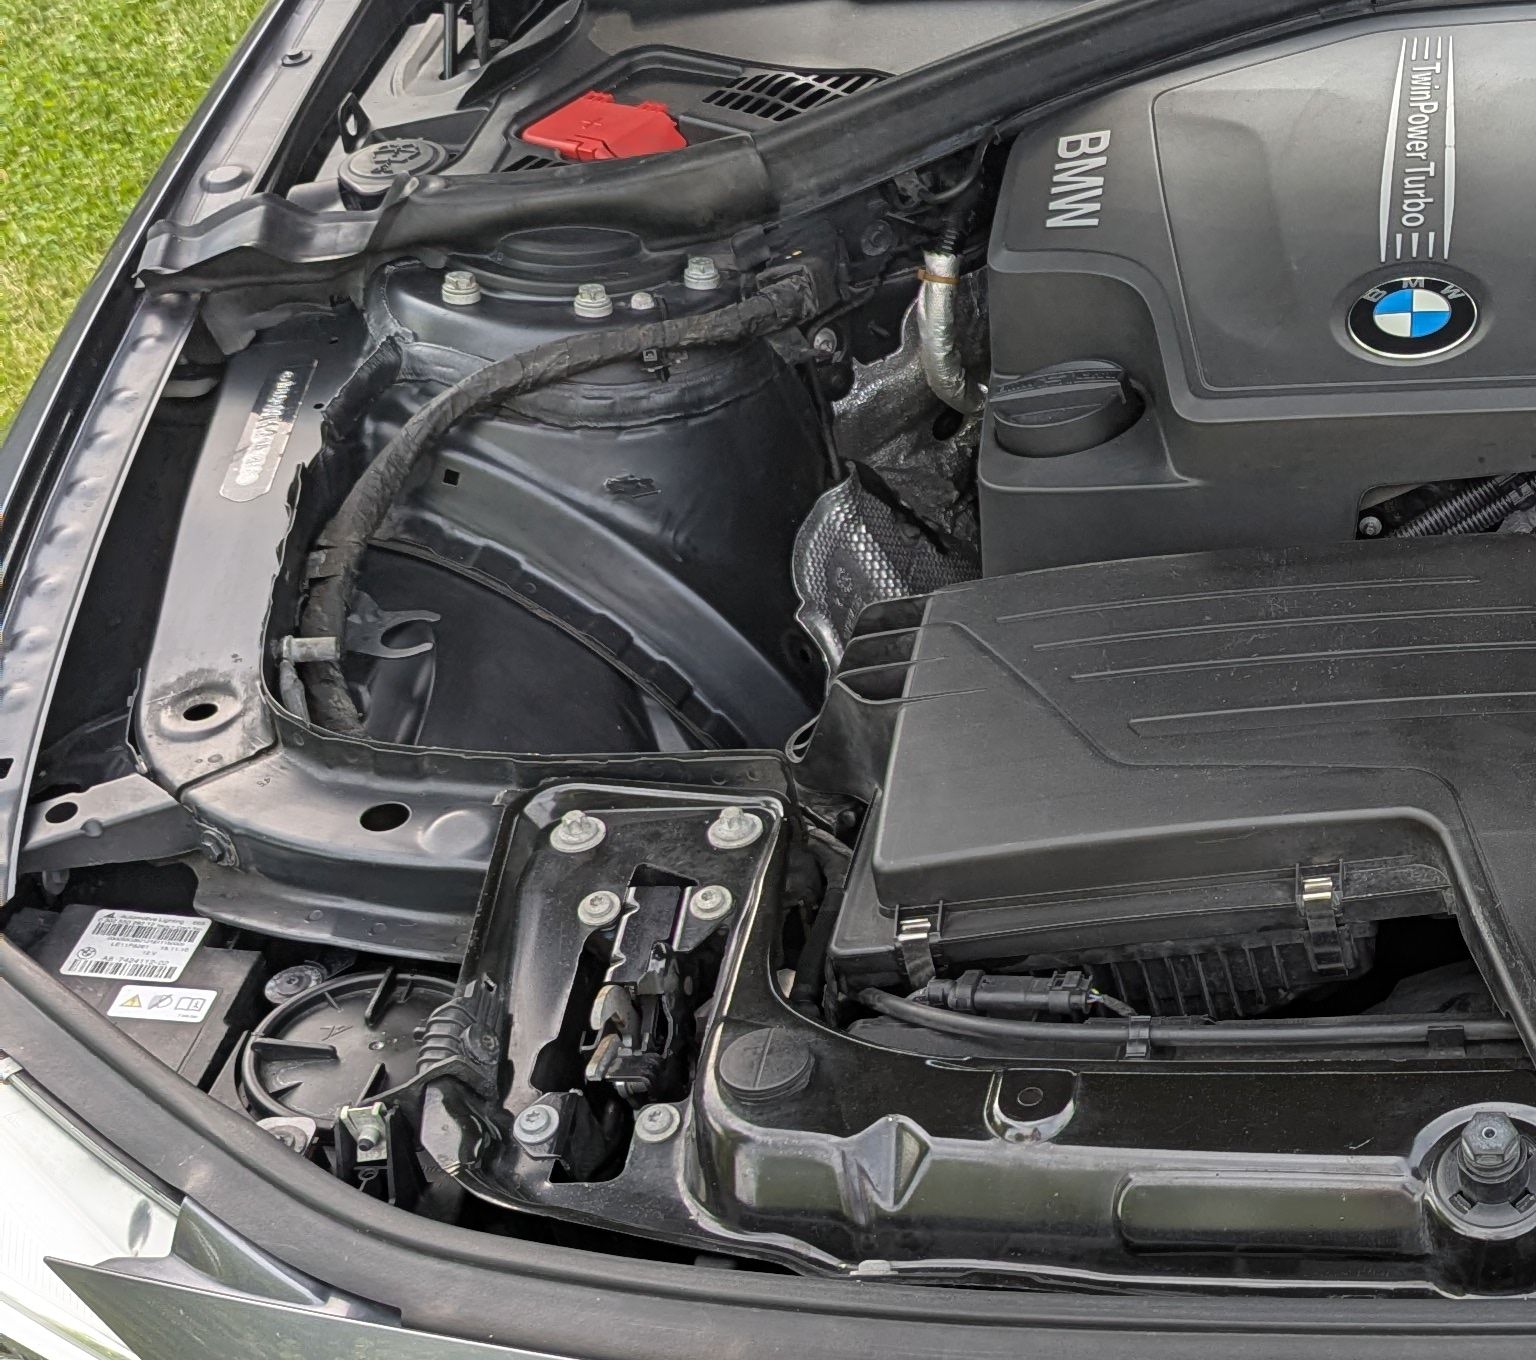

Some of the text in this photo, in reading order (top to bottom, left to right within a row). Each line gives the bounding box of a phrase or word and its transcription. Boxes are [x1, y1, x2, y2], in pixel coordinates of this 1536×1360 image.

[1045, 129, 1111, 230] BMW
[1400, 161, 1435, 228] Turbo
[1362, 278, 1465, 302] BMW
